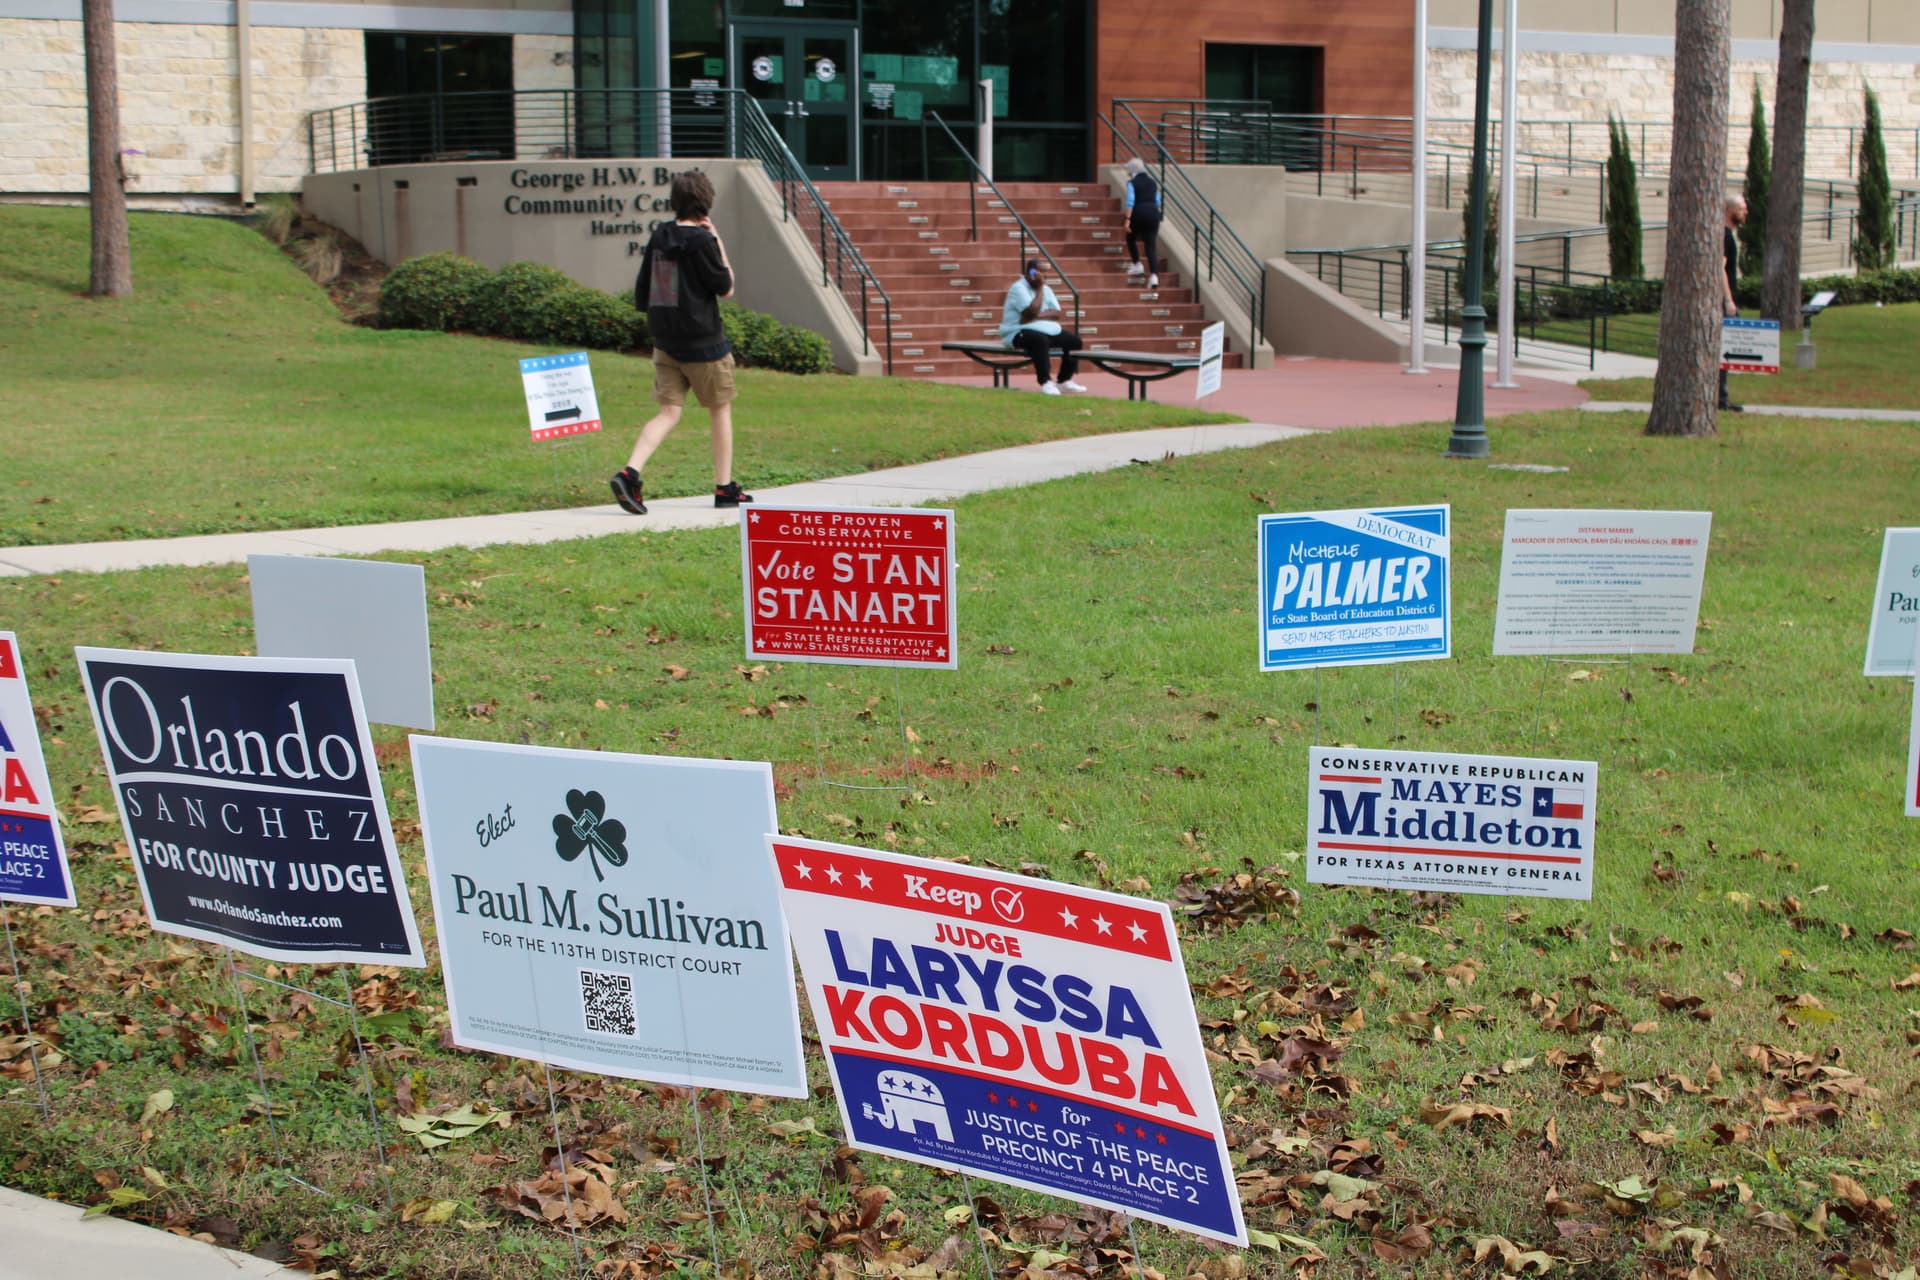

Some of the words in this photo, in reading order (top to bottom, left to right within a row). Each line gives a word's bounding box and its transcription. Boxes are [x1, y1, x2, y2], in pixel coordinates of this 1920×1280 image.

[511, 168, 585, 193] George
[592, 167, 646, 187] H.W.
[504, 194, 625, 217] Community
[591, 219, 643, 236] Harris
[779, 524, 913, 540] CONSERVATIVE
[790, 513, 824, 525] THE
[832, 514, 901, 527] PROVEN
[1356, 516, 1436, 549] DEMOCRAT
[832, 551, 940, 586] STAN
[1288, 540, 1361, 564] MICHELLE
[1272, 555, 1431, 612] PALMER
[757, 586, 941, 626] STANART
[1272, 614, 1286, 625] for
[1287, 613, 1308, 624] State
[1311, 611, 1338, 622] Board
[1340, 609, 1350, 620] of
[1351, 606, 1394, 619] Education
[1396, 604, 1427, 616] District
[1428, 604, 1435, 613] 6
[785, 631, 822, 643] STATE
[827, 633, 934, 648] REPRESENTATIVE
[1281, 632, 1307, 645] SEND
[1309, 629, 1336, 642] MORE
[1337, 626, 1383, 640] TEACHERS
[1384, 626, 1397, 636] TO
[101, 675, 357, 781] Orlando
[1320, 757, 1460, 776] CONSERVATIVE
[1468, 765, 1585, 783] REPUBLICAN
[1390, 777, 1522, 808] MAYES
[126, 787, 376, 842] SANCHEZ
[475, 802, 516, 848] Elect
[1317, 788, 1583, 850] Middleton
[3, 841, 50, 860] PEACE
[139, 838, 185, 872] FOR
[186, 847, 277, 889] COUNTY
[288, 861, 388, 894] JUDGE
[34, 864, 45, 879] 2
[1317, 855, 1348, 867] FOR
[1356, 858, 1405, 871] TEXAS
[1413, 861, 1499, 877] ATTORNEY
[1507, 867, 1583, 882] GENERAL
[187, 894, 343, 928] www.OrlandoSanchez.com
[903, 873, 983, 915] Keep
[451, 873, 532, 924] Paul
[538, 884, 591, 933] M.
[596, 892, 768, 951] Sullivan
[482, 930, 513, 948] FOR
[517, 936, 546, 953] THE
[551, 941, 597, 961] 113TH
[601, 948, 676, 969] DISTRICT
[681, 957, 742, 976] COURT
[934, 921, 1023, 959] JUDGE
[823, 928, 1162, 1050] LARYSSA
[822, 983, 1198, 1117] KORDUBA
[1061, 1105, 1091, 1128] for
[964, 1108, 1047, 1143] JUSTICE
[1052, 1127, 1083, 1150] OF
[1086, 1135, 1133, 1164] THE
[1135, 1145, 1209, 1186] PEACE
[981, 1132, 1084, 1172] PRECINCT
[1092, 1157, 1106, 1180] 4
[1110, 1162, 1178, 1200] PLACE
[1184, 1184, 1201, 1206] 2
